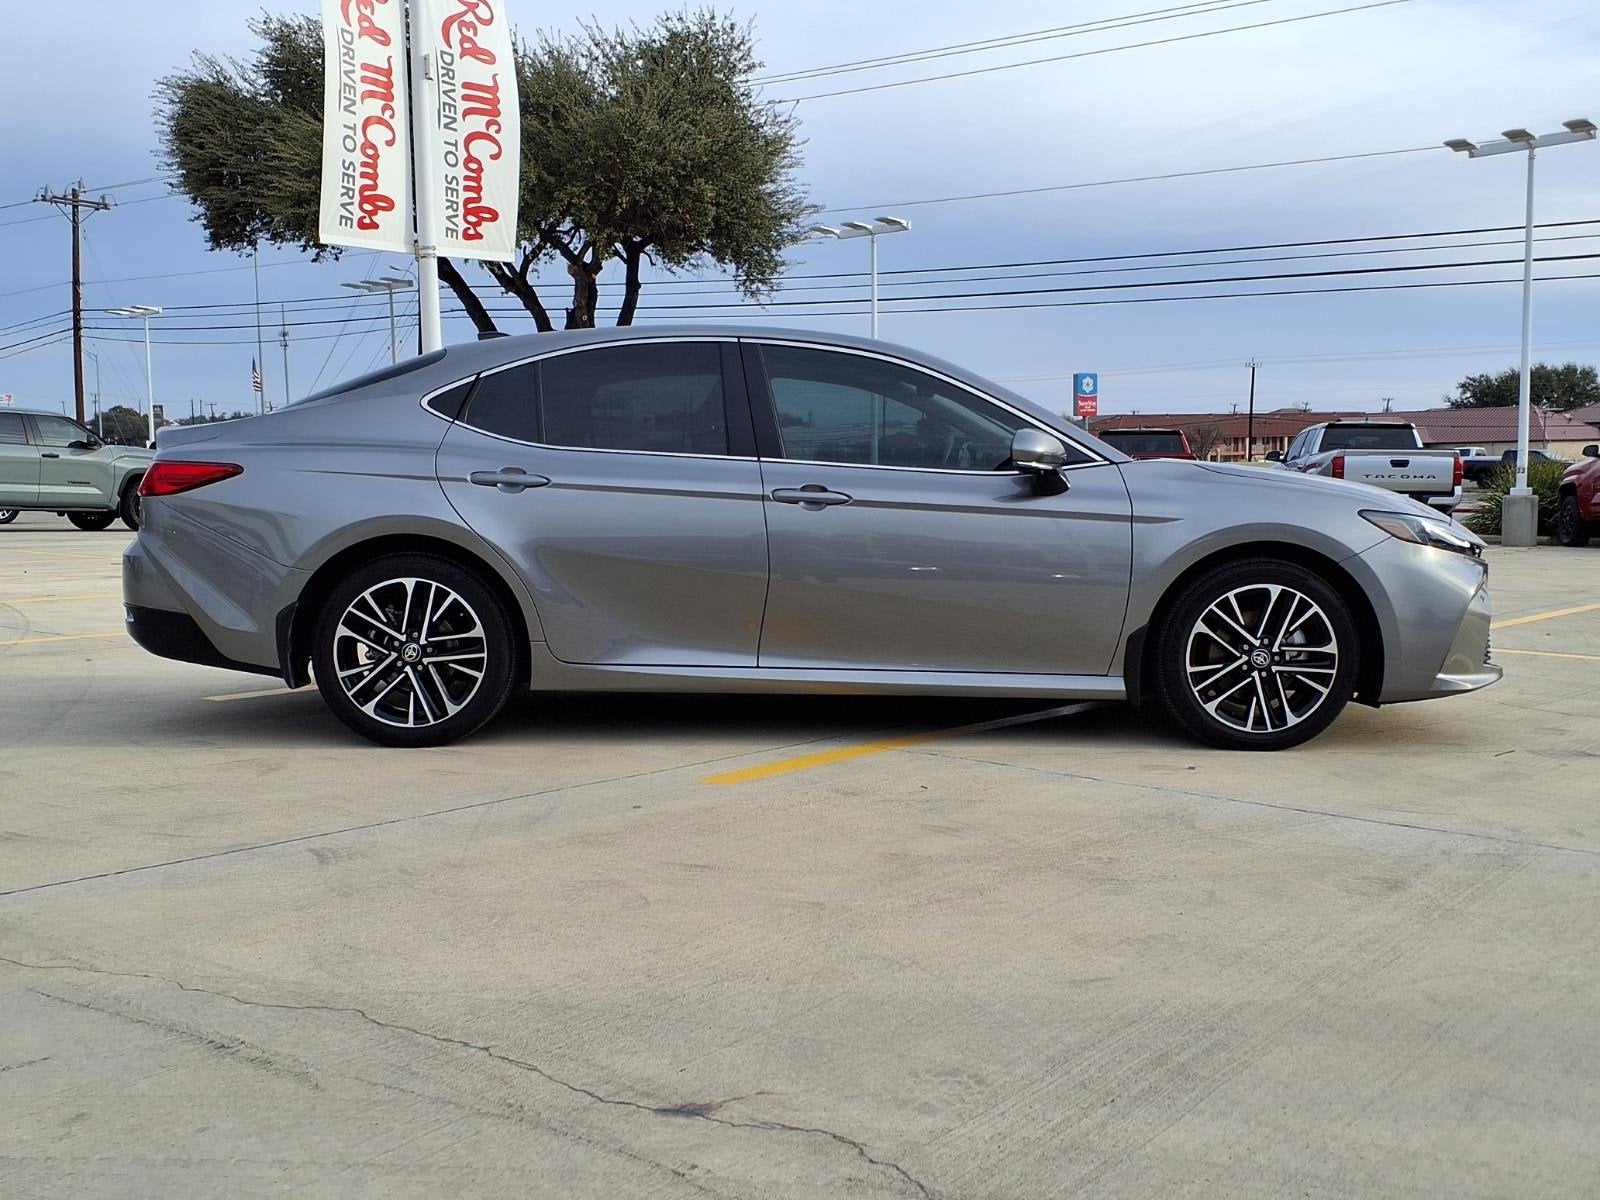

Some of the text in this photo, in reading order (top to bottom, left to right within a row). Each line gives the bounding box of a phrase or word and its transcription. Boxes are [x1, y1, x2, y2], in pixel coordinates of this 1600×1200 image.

[339, 27, 357, 229] DRIVEN TO SERVE
[357, 55, 396, 231] McCombs
[439, 49, 459, 240] DRIVEN TO SERVE
[441, 0, 502, 242] Red McCombs
